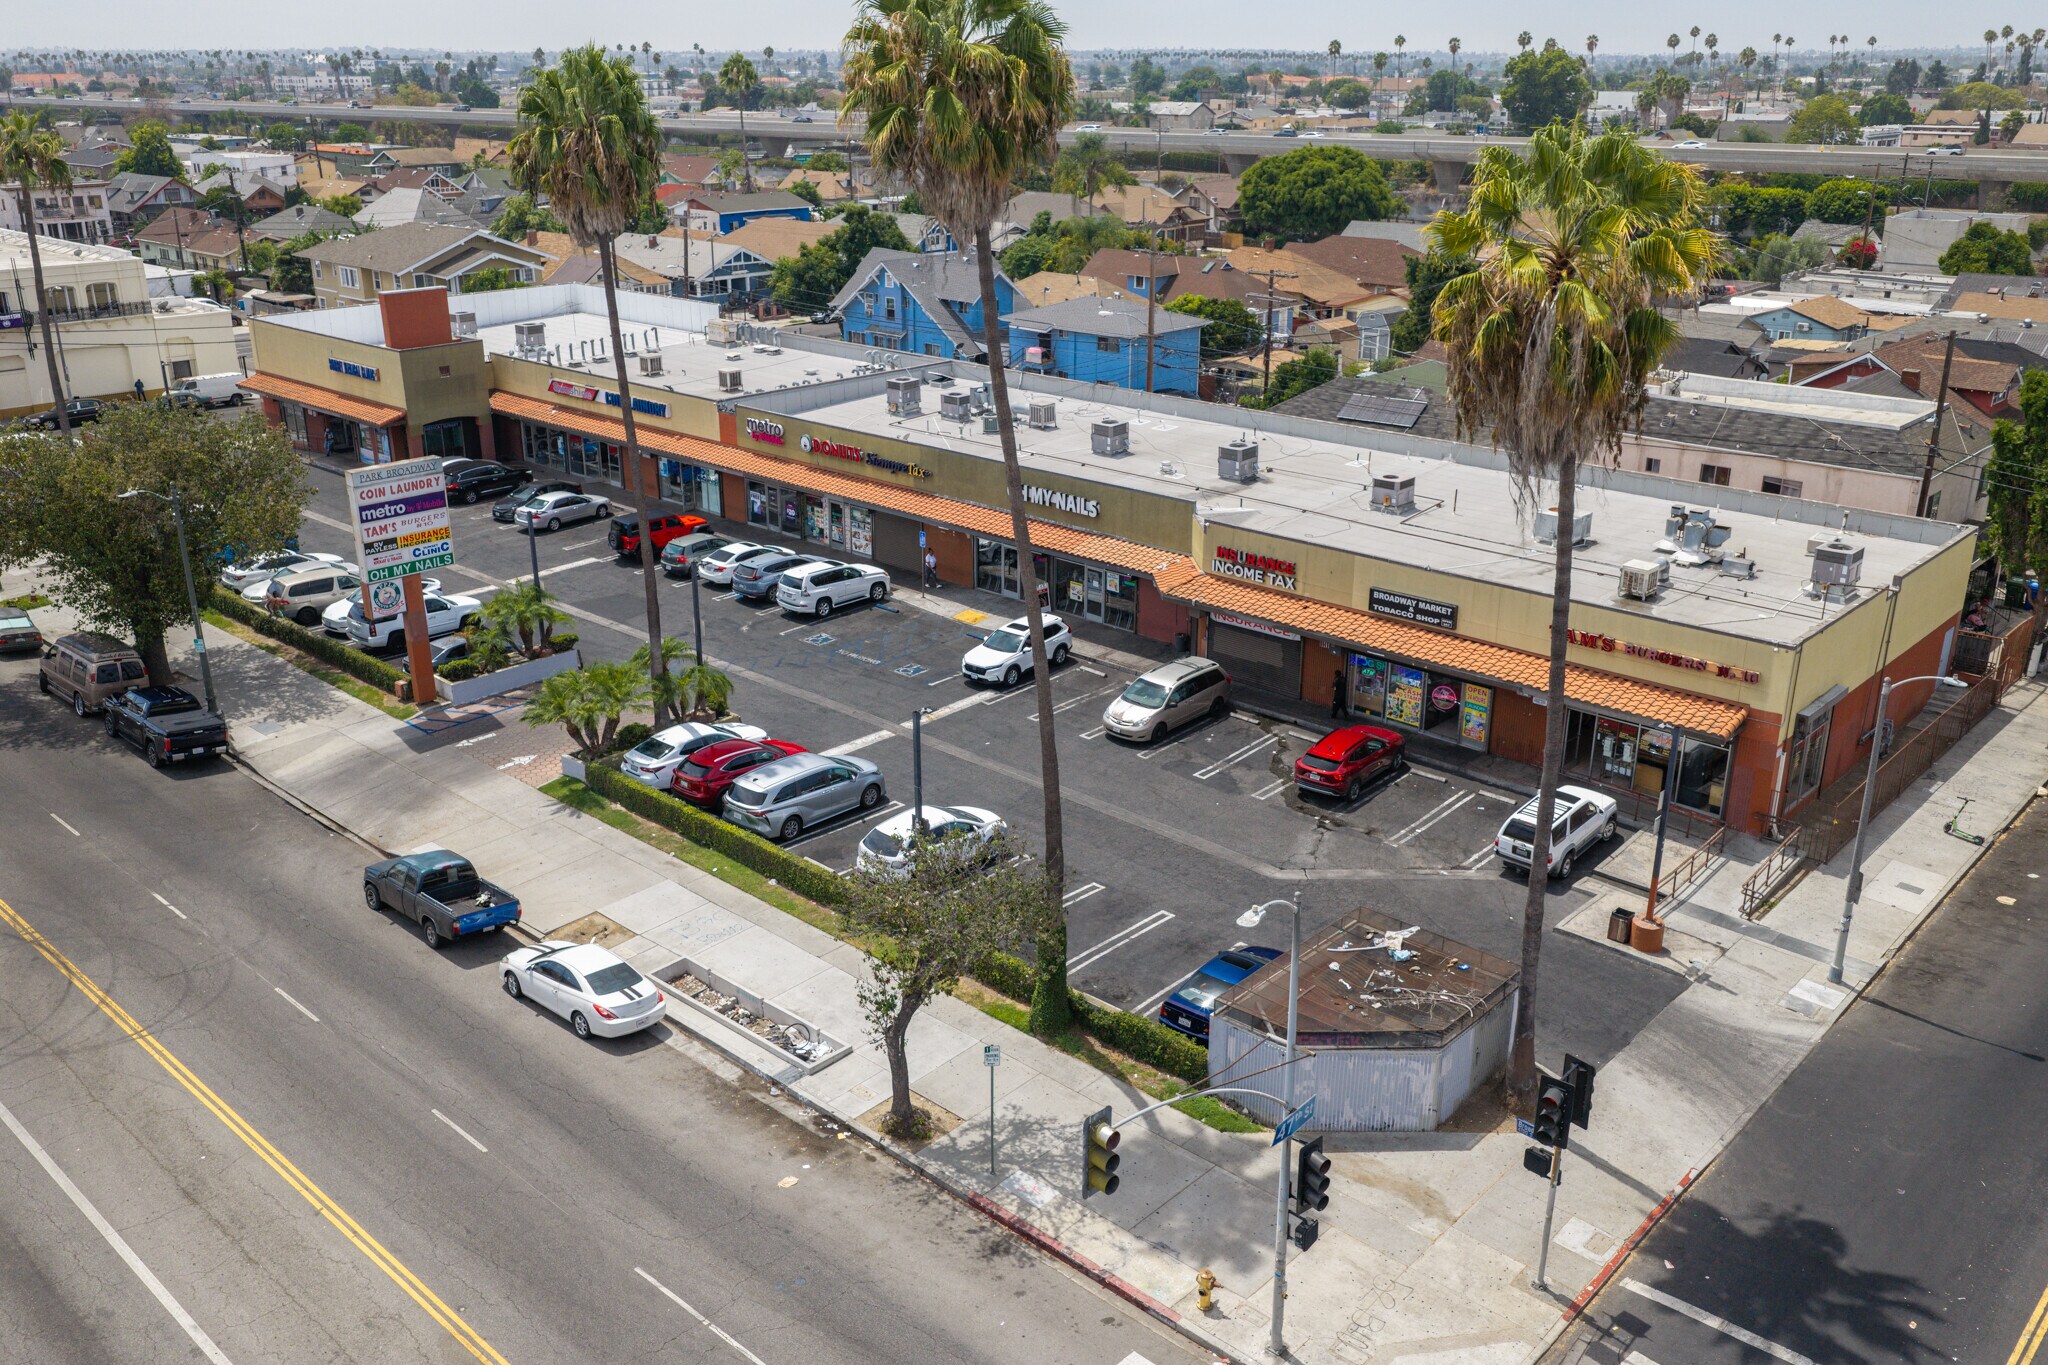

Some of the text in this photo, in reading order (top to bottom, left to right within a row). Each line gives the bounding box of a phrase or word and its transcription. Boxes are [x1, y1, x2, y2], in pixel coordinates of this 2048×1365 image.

[632, 397, 666, 417] AUNDRY
[746, 418, 783, 437] metro
[812, 437, 862, 463] DONUTS
[360, 461, 437, 483] PARK BROADWAY
[360, 476, 440, 500] COIN LAUNDRY
[361, 503, 406, 520] metro
[1031, 486, 1054, 507] MY
[1055, 492, 1098, 518] NAILS
[364, 511, 446, 538] TAM'S BURGERS
[400, 526, 450, 543] INSURANCE
[365, 543, 398, 555] PAYLESS
[373, 541, 384, 549] RV
[400, 539, 433, 549] INCOME
[413, 541, 450, 558] CLINIC
[370, 569, 389, 580] OH
[394, 563, 412, 575] MY
[416, 554, 453, 571] NAILS
[1216, 546, 1296, 576] INSURANCE
[1212, 559, 1296, 590] INCOME TAX
[1373, 591, 1453, 616] BROADWAY MARKET
[1373, 603, 1414, 619] TOBACCO
[1416, 614, 1440, 625] SHOP
[1215, 612, 1291, 637] INSURANCE
[1624, 641, 1708, 672] BURGERS
[1740, 669, 1759, 684] 10
[1467, 685, 1487, 697] OPEN
